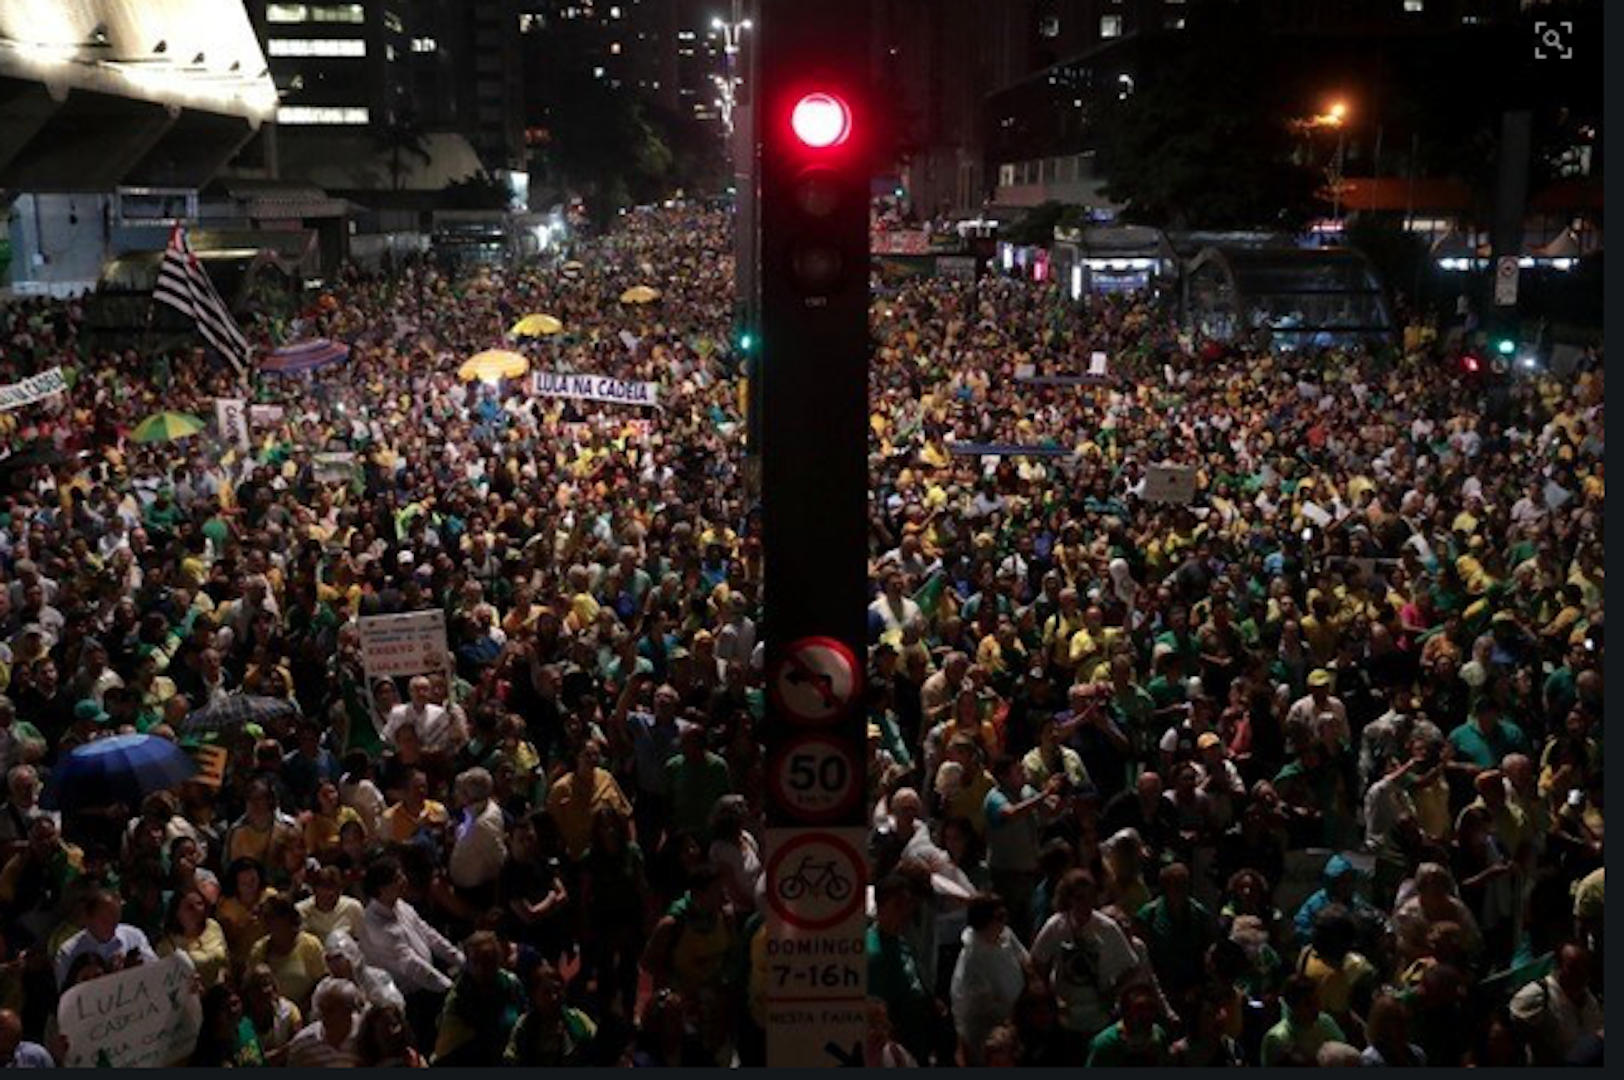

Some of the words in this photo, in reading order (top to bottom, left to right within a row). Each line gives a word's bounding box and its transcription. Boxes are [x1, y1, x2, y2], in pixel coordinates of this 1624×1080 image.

[537, 375, 568, 393] LULA
[573, 378, 592, 396] NA
[599, 380, 648, 401] CADEIA
[790, 754, 846, 792] 50
[768, 938, 864, 954] DOMINGO
[773, 964, 859, 988] 7-16h
[76, 979, 150, 1020] LULA
